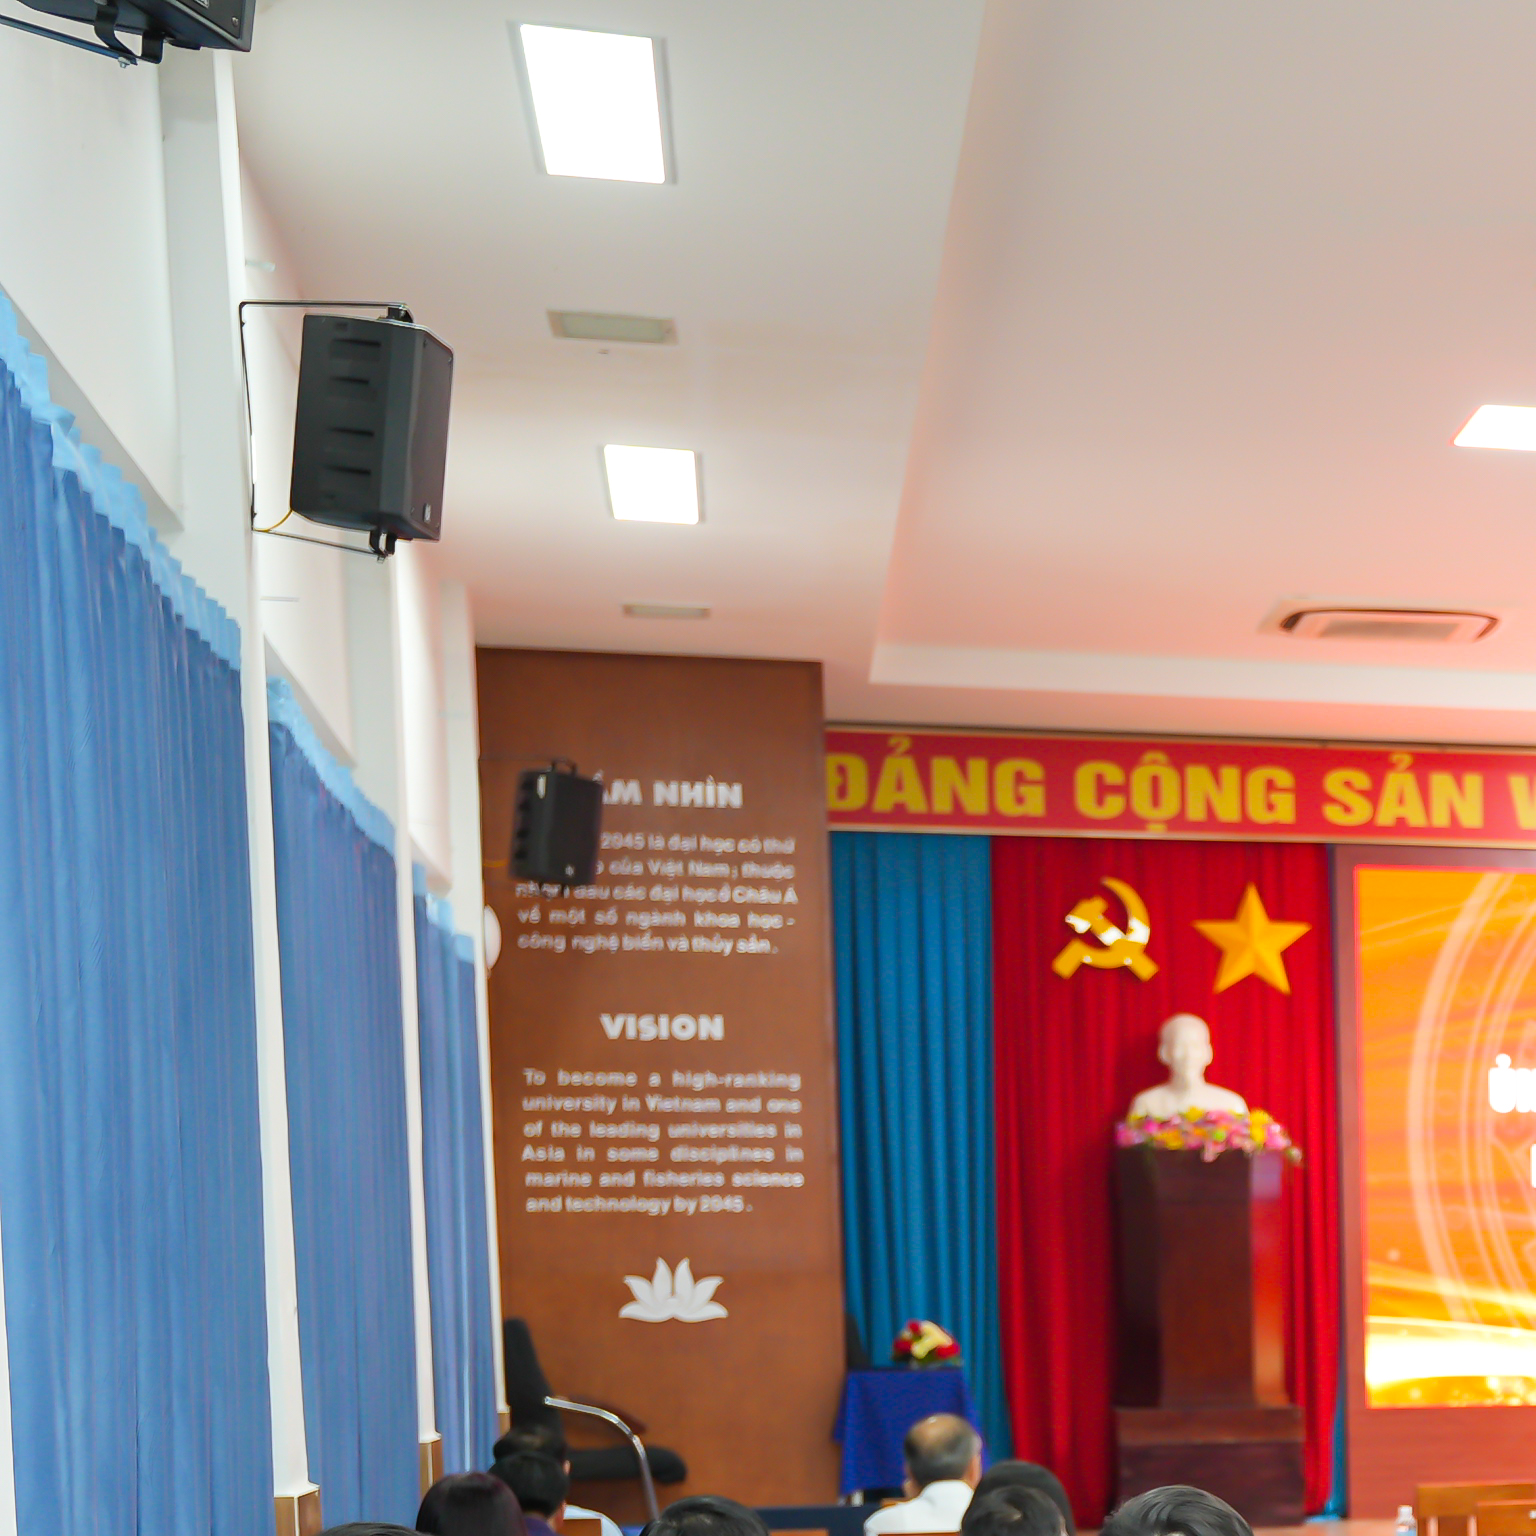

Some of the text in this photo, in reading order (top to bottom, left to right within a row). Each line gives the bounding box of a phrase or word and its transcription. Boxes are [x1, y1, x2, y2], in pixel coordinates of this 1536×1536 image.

[652, 775, 744, 808] NHÌN
[828, 737, 1046, 819] ĐẢNG
[1074, 752, 1297, 832] CỘNG
[1323, 754, 1484, 829] SẢN
[602, 831, 646, 851] 2045
[600, 1012, 724, 1041] VISION
[523, 1067, 546, 1087] To
[557, 1068, 638, 1088] become
[649, 1071, 661, 1088] a
[522, 1094, 617, 1116] university
[622, 1094, 640, 1112] in
[645, 1094, 721, 1113] Vietnam
[726, 1096, 762, 1114] and
[523, 1119, 543, 1138] of
[551, 1120, 582, 1139] the
[589, 1120, 660, 1142] leading
[784, 1121, 803, 1139] in
[521, 1144, 566, 1162] Asia
[576, 1145, 595, 1162] in
[607, 1147, 660, 1163] some
[785, 1145, 804, 1163] in
[525, 1171, 593, 1188] marine
[599, 1170, 636, 1188] and
[525, 1195, 562, 1213] and
